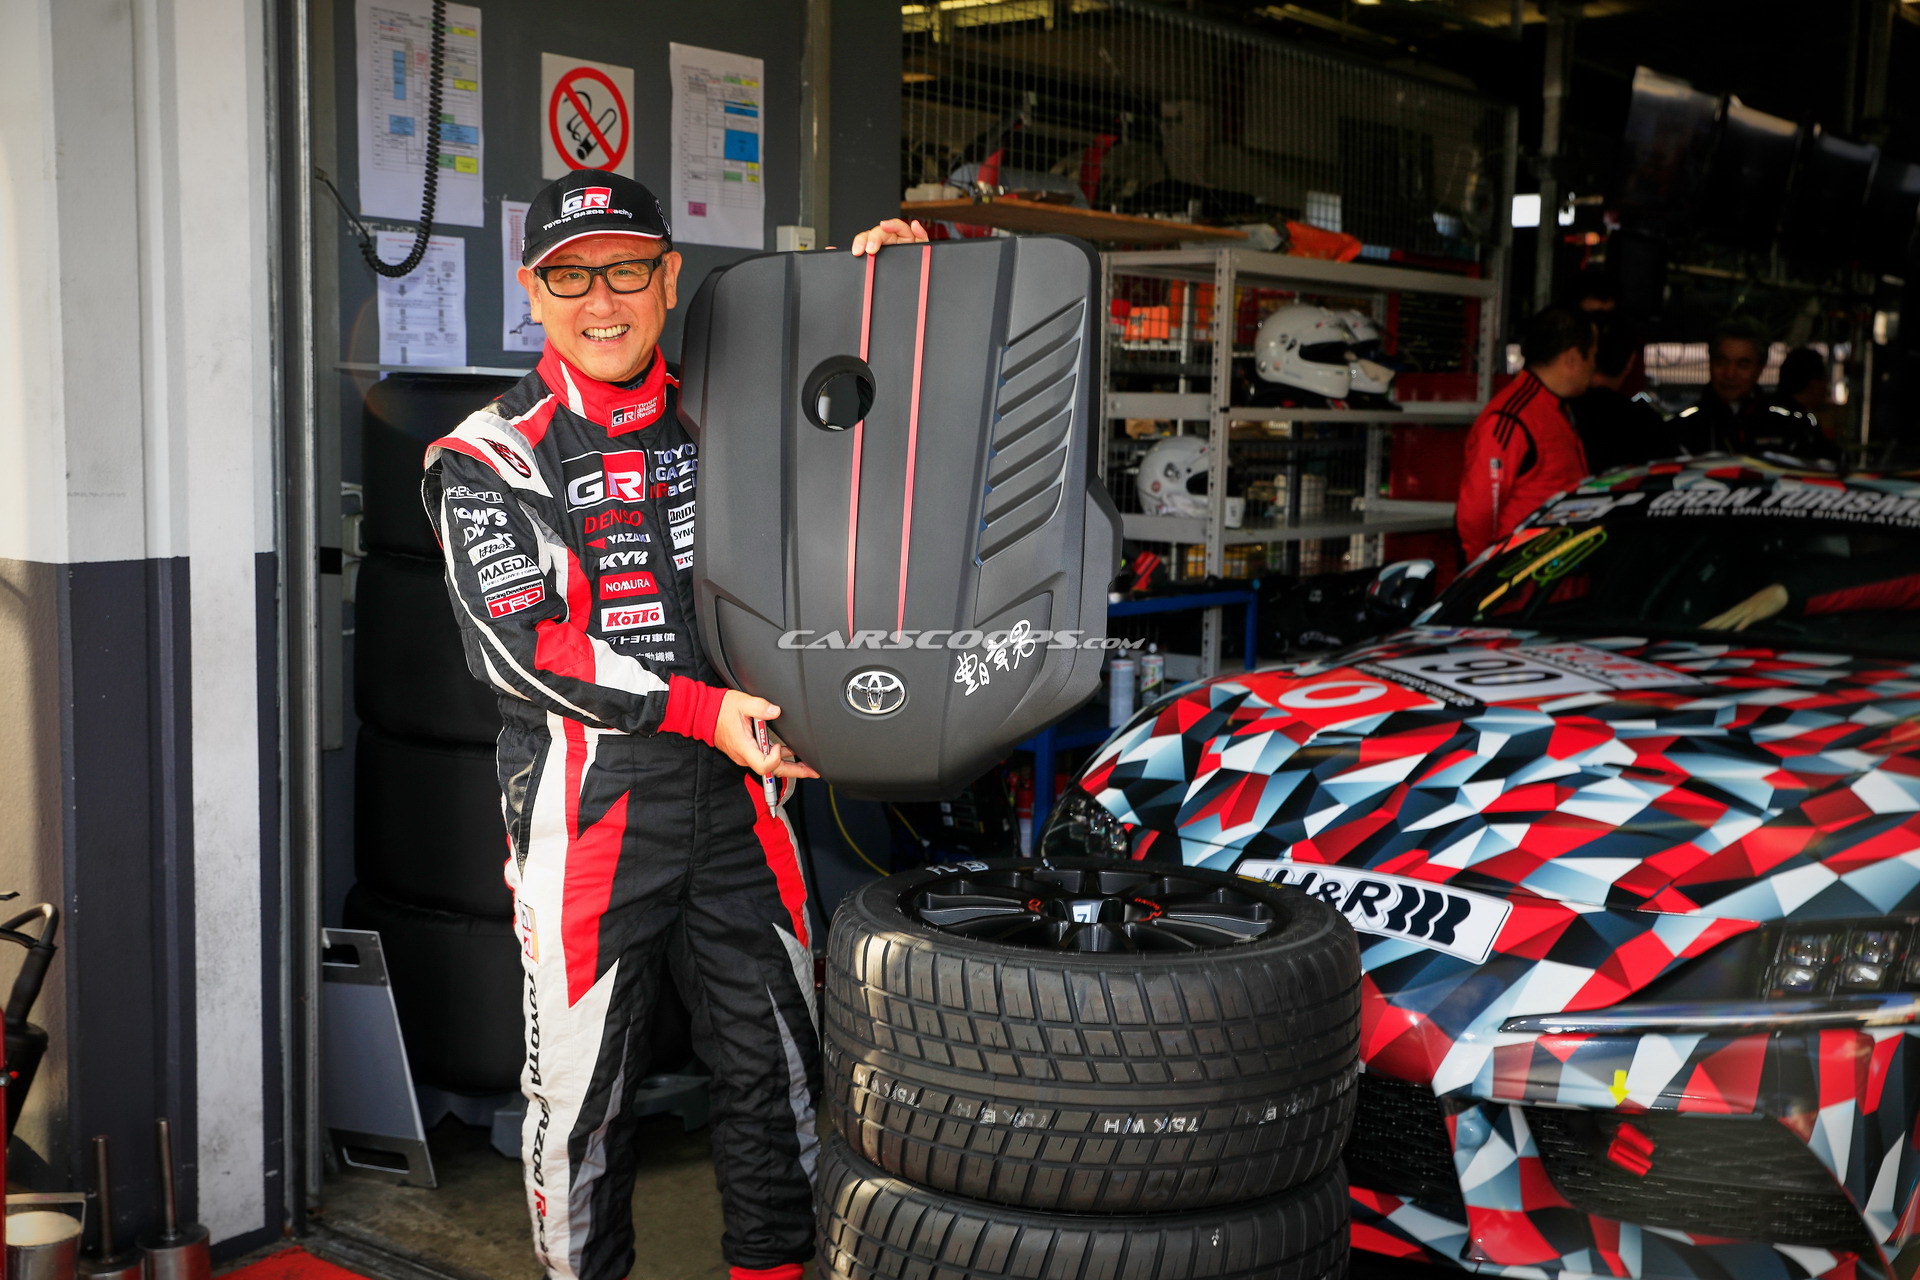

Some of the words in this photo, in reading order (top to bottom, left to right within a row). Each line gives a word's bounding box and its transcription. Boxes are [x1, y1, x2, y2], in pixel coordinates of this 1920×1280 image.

[563, 193, 608, 213] GR
[542, 217, 572, 231] TOYOTA
[573, 209, 604, 219] GAZOO
[606, 208, 633, 219] Racing
[613, 411, 635, 425] GR
[567, 470, 642, 506] GR
[1649, 487, 1762, 510] GRAN
[584, 508, 644, 534] DENSO
[606, 532, 651, 544] YAZAKI
[480, 556, 536, 585] MAEDA
[600, 551, 649, 571] KYB
[486, 591, 507, 602] Racing
[505, 581, 543, 596] Development
[605, 578, 651, 593] NOMURA
[490, 590, 541, 613] TRD
[528, 971, 541, 1086] TOYOTA
